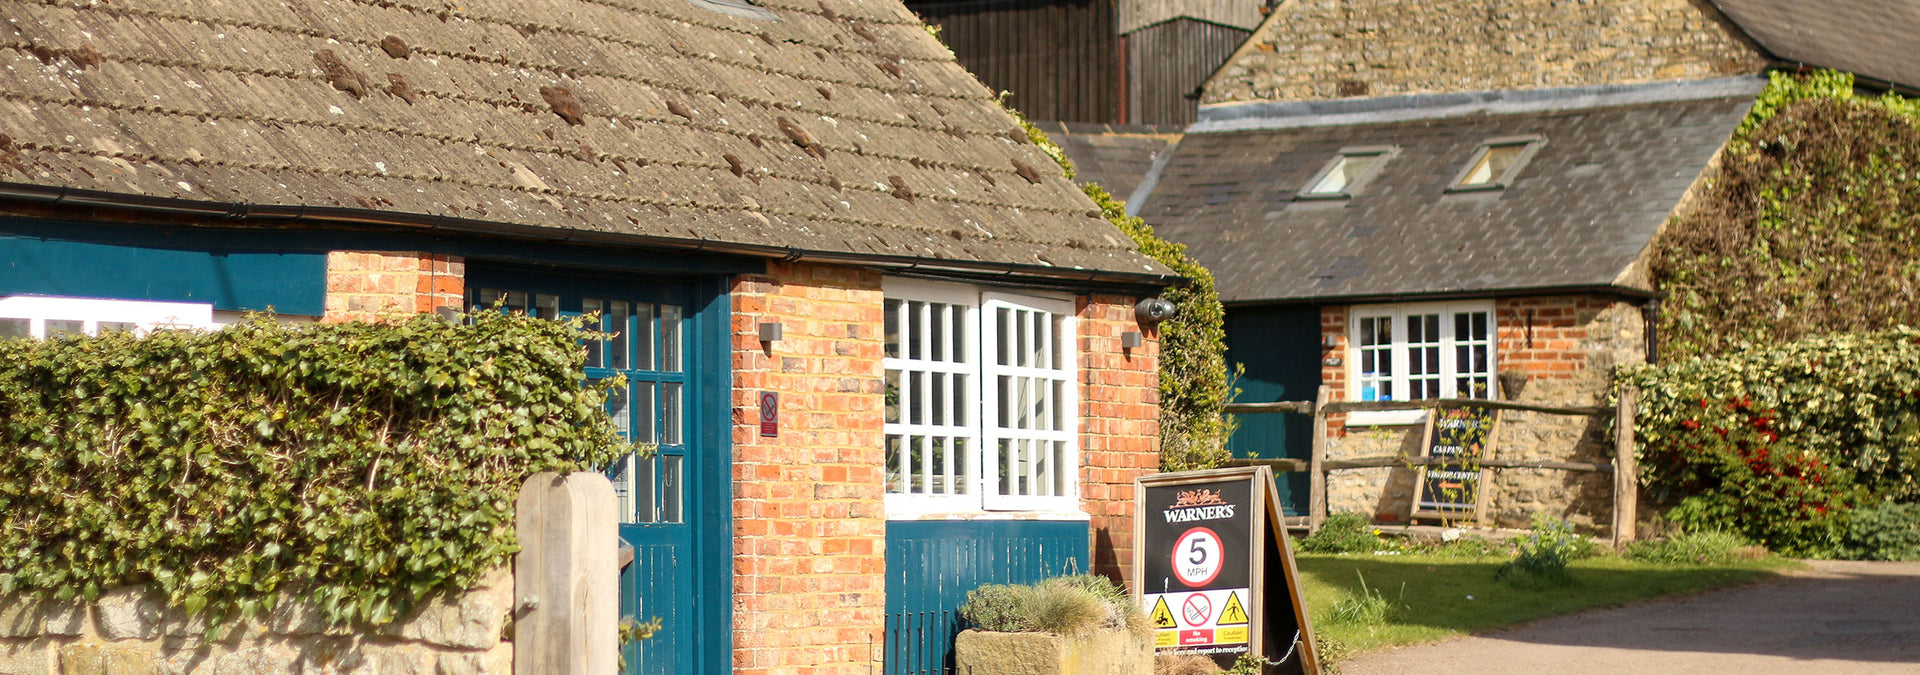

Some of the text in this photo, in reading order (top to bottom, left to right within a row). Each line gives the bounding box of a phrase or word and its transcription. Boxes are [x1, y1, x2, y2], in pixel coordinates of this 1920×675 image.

[1163, 505, 1235, 523] WARNER'S
[1189, 538, 1207, 565] 5
[1187, 567, 1208, 577] MPH
[1185, 636, 1208, 644] smoking
[1215, 646, 1223, 654] to
